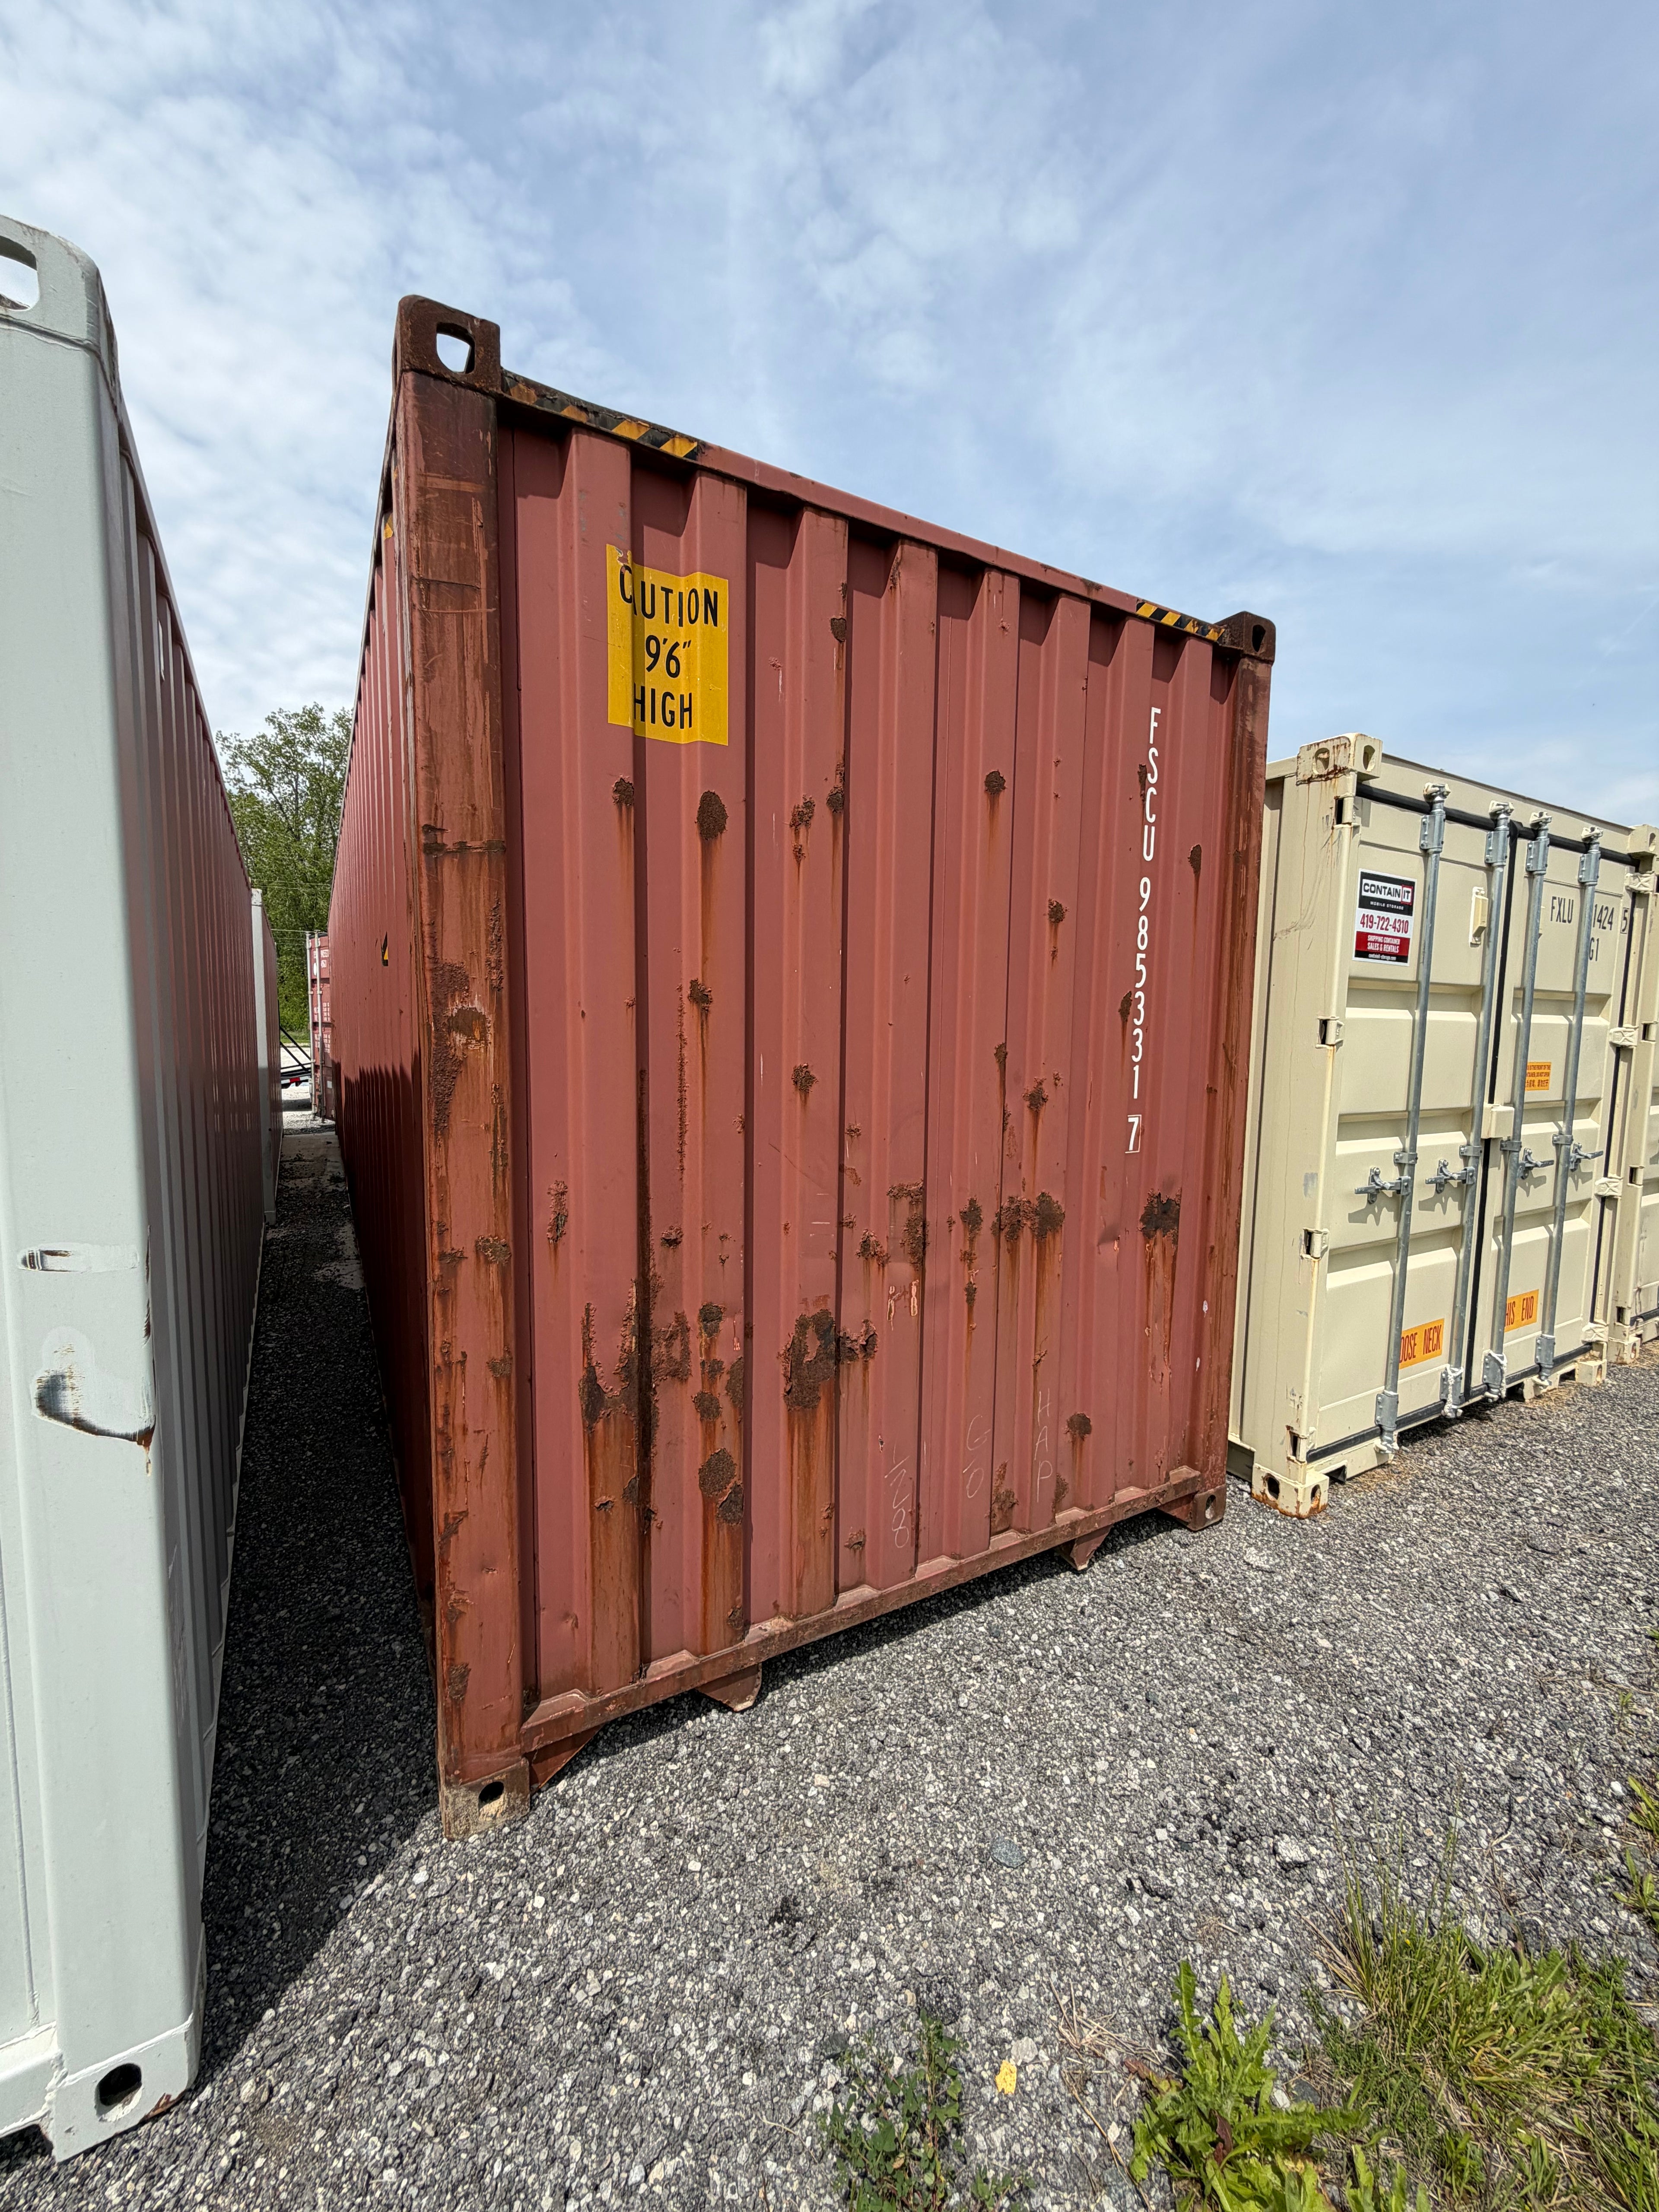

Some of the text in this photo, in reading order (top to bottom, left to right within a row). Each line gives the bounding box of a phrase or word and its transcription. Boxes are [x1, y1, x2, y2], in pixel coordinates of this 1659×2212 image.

[620, 565, 718, 627] CUTION
[634, 683, 692, 729] HIGH
[1143, 707, 1161, 861] FSCU
[1360, 913, 1409, 934] 419-722-4310
[1550, 896, 1574, 924] FXLU
[1367, 942, 1379, 951] SALES
[1383, 944, 1399, 953] RENTALS
[1131, 877, 1150, 1099] 985331
[1505, 1296, 1534, 1326] HIS END
[1399, 1324, 1442, 1363] OOSE NECK
